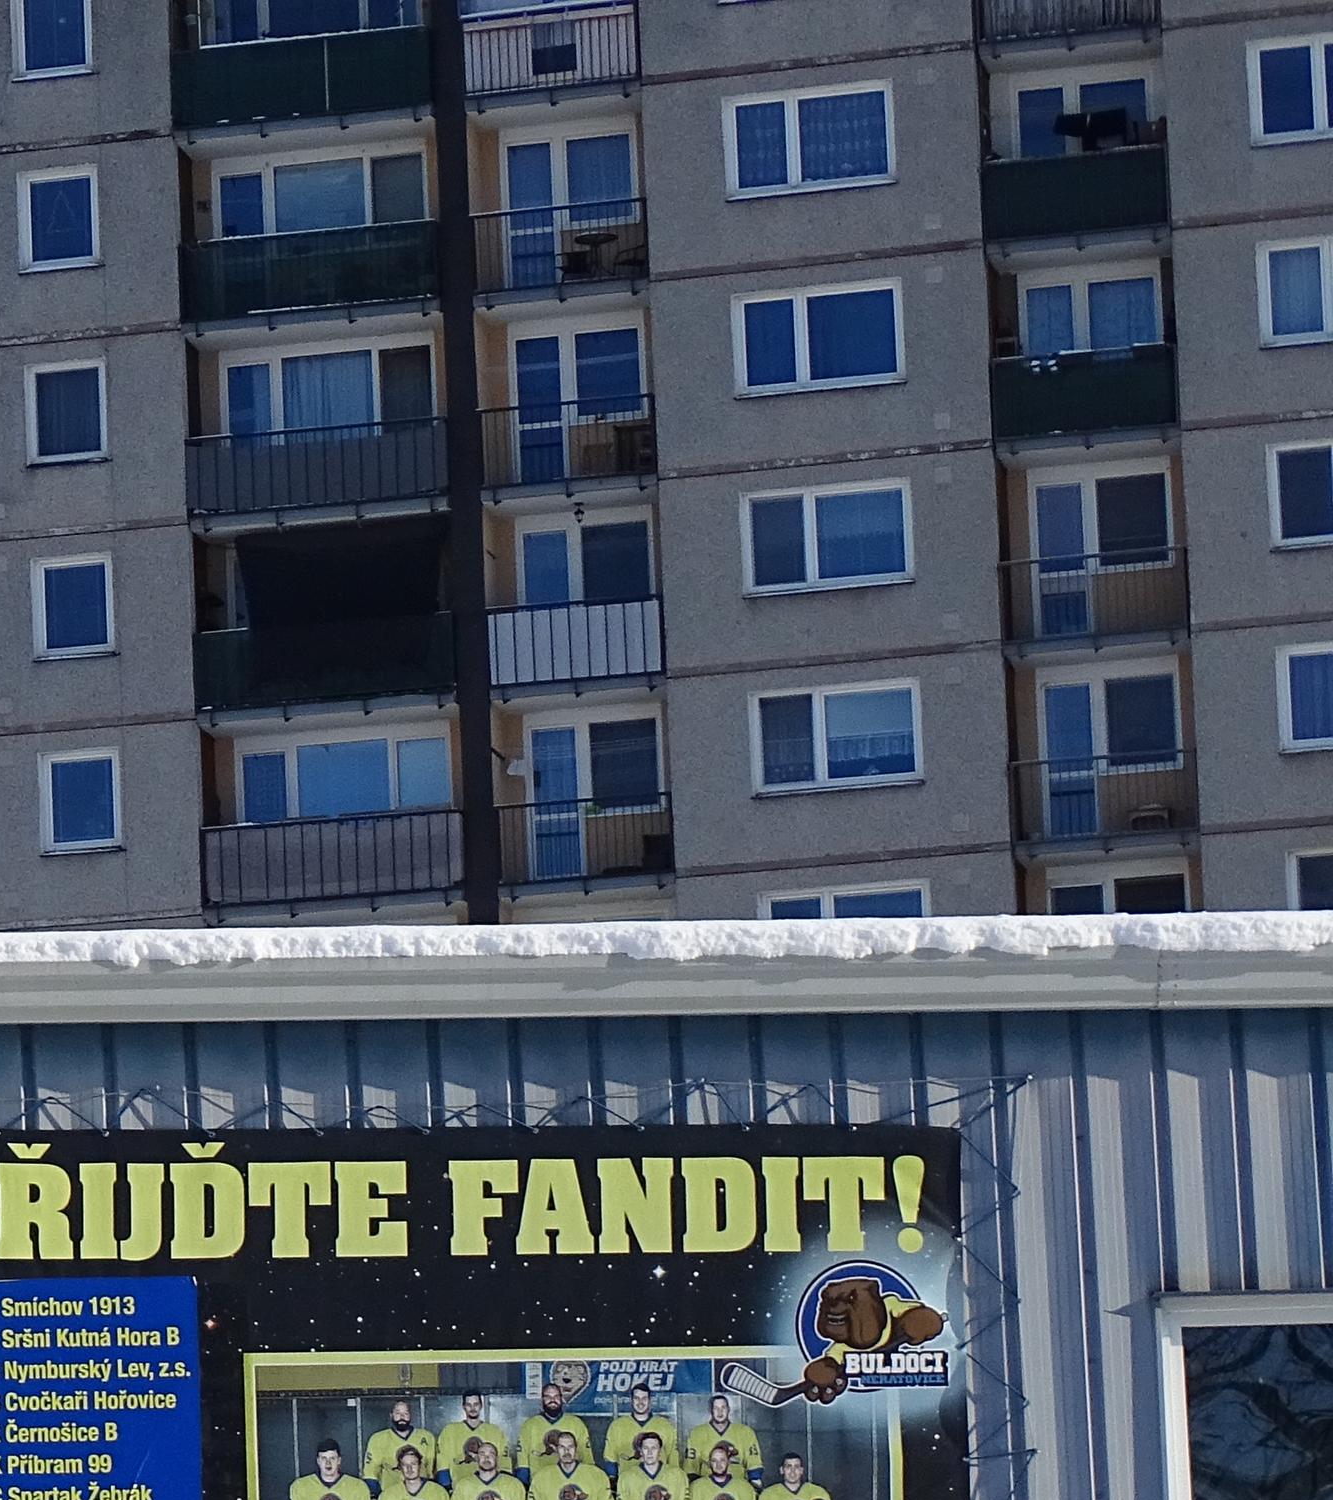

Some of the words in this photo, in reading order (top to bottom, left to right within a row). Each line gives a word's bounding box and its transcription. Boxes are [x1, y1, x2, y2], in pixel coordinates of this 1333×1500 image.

[448, 1155, 925, 1257] FANDIT!
[1, 1296, 84, 1317] Smíchov
[88, 1296, 135, 1316] 1913
[1, 1328, 51, 1349] Sršni
[56, 1326, 111, 1348] Kutná
[116, 1327, 161, 1347] Hora
[166, 1326, 180, 1346] B
[4, 1358, 112, 1384] Nymburský
[117, 1358, 154, 1381] Lev,
[158, 1361, 191, 1377] z.s.
[844, 1352, 944, 1374] BULDOCI
[596, 1373, 674, 1391] HOKEJ
[5, 1390, 88, 1412] Cvočkaři
[94, 1389, 177, 1410] Hořovice
[5, 1418, 100, 1443] Černošice
[104, 1422, 118, 1441] B
[7, 1454, 83, 1475] Příbram
[88, 1454, 112, 1474] 99
